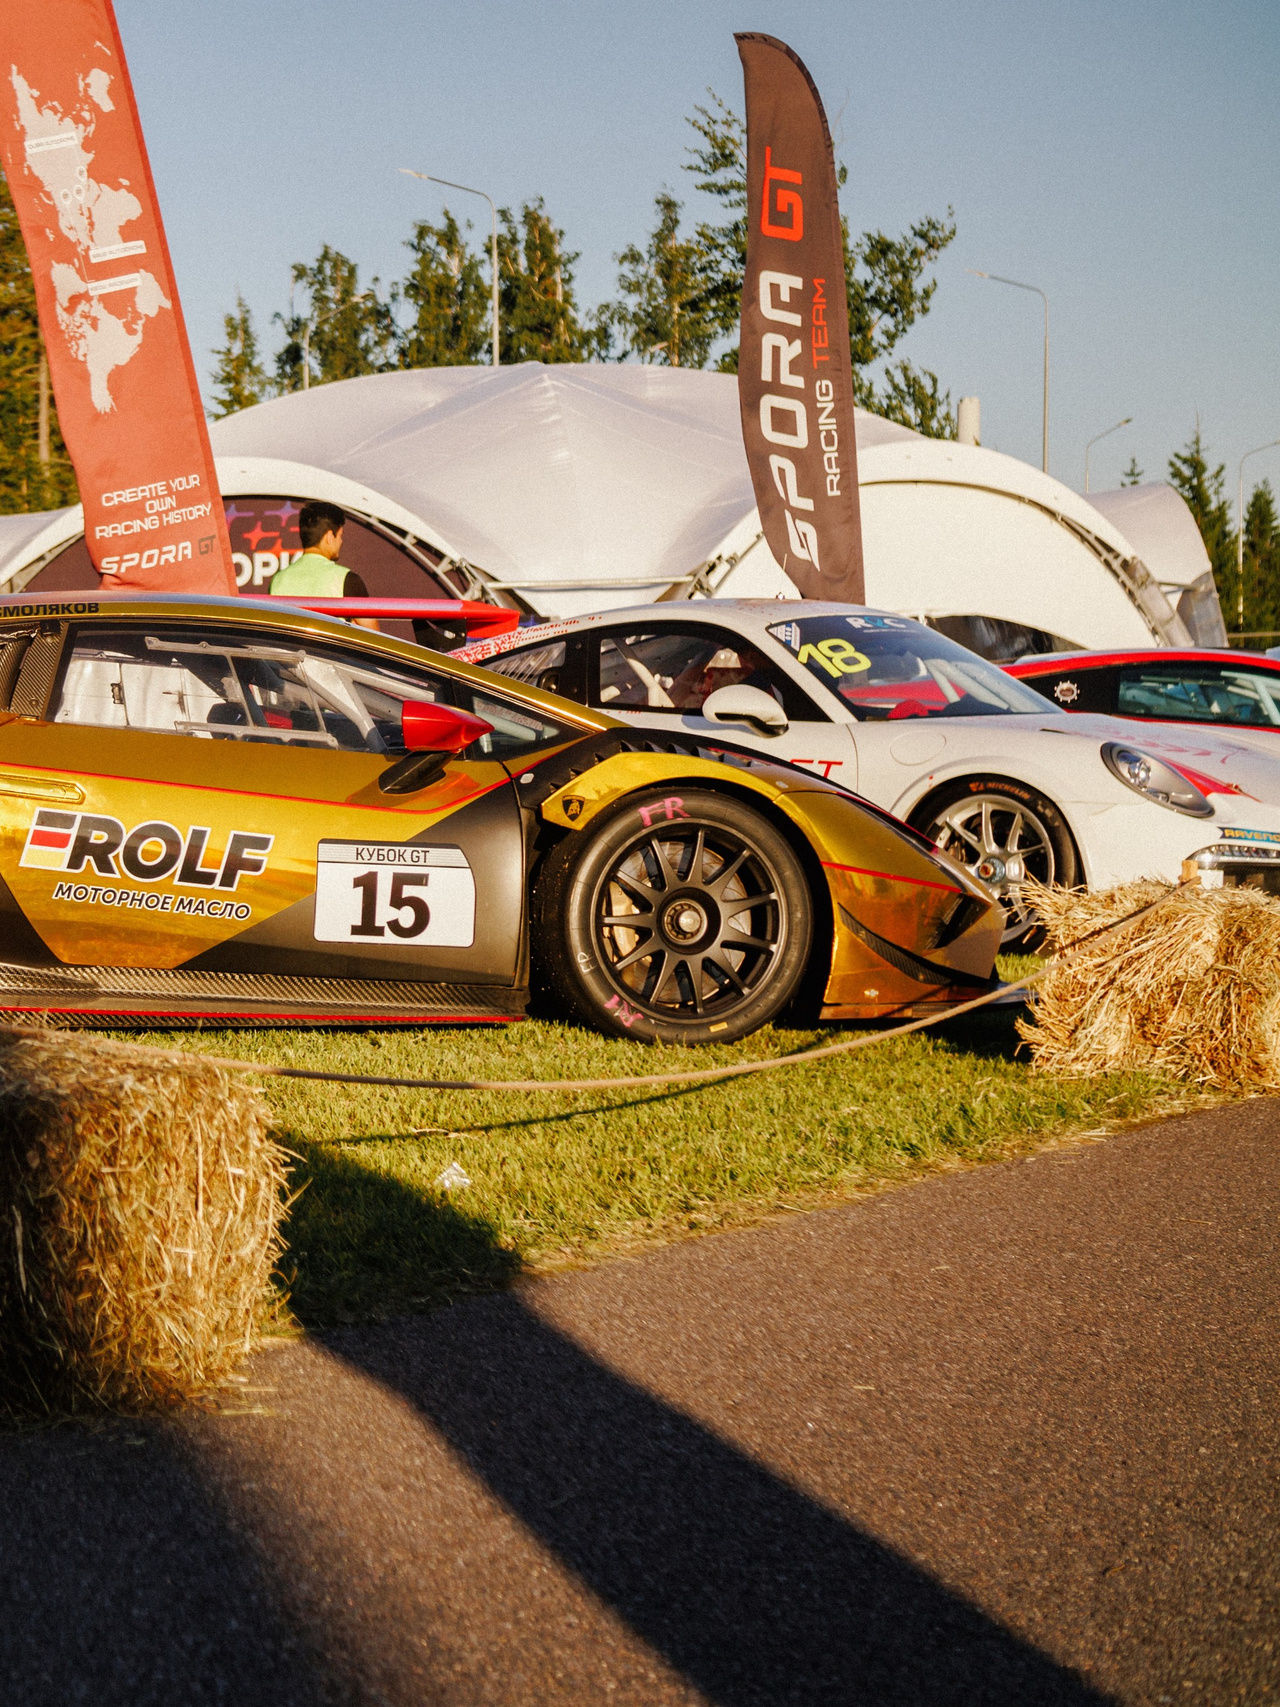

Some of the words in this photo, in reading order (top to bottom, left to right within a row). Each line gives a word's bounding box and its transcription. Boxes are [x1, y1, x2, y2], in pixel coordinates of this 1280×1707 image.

[761, 146, 803, 242] GT
[812, 278, 829, 369] TEAM
[759, 270, 820, 571] SPORA
[815, 379, 841, 497] RACING
[101, 481, 168, 507] CREATE
[169, 474, 201, 492] YOUR
[145, 496, 177, 514] OWN
[95, 515, 160, 539] RACING
[162, 503, 212, 527] HISTORY
[100, 541, 192, 574] SPORA
[198, 534, 216, 555] GT
[797, 638, 872, 679] 18
[637, 796, 690, 827] FR
[64, 812, 275, 891] ROLF
[355, 847, 407, 863] КУБОК
[410, 850, 430, 863] GT
[52, 882, 173, 911] МОТОРНОЕ
[174, 898, 251, 920] МАСЛО
[350, 871, 431, 938] 15
